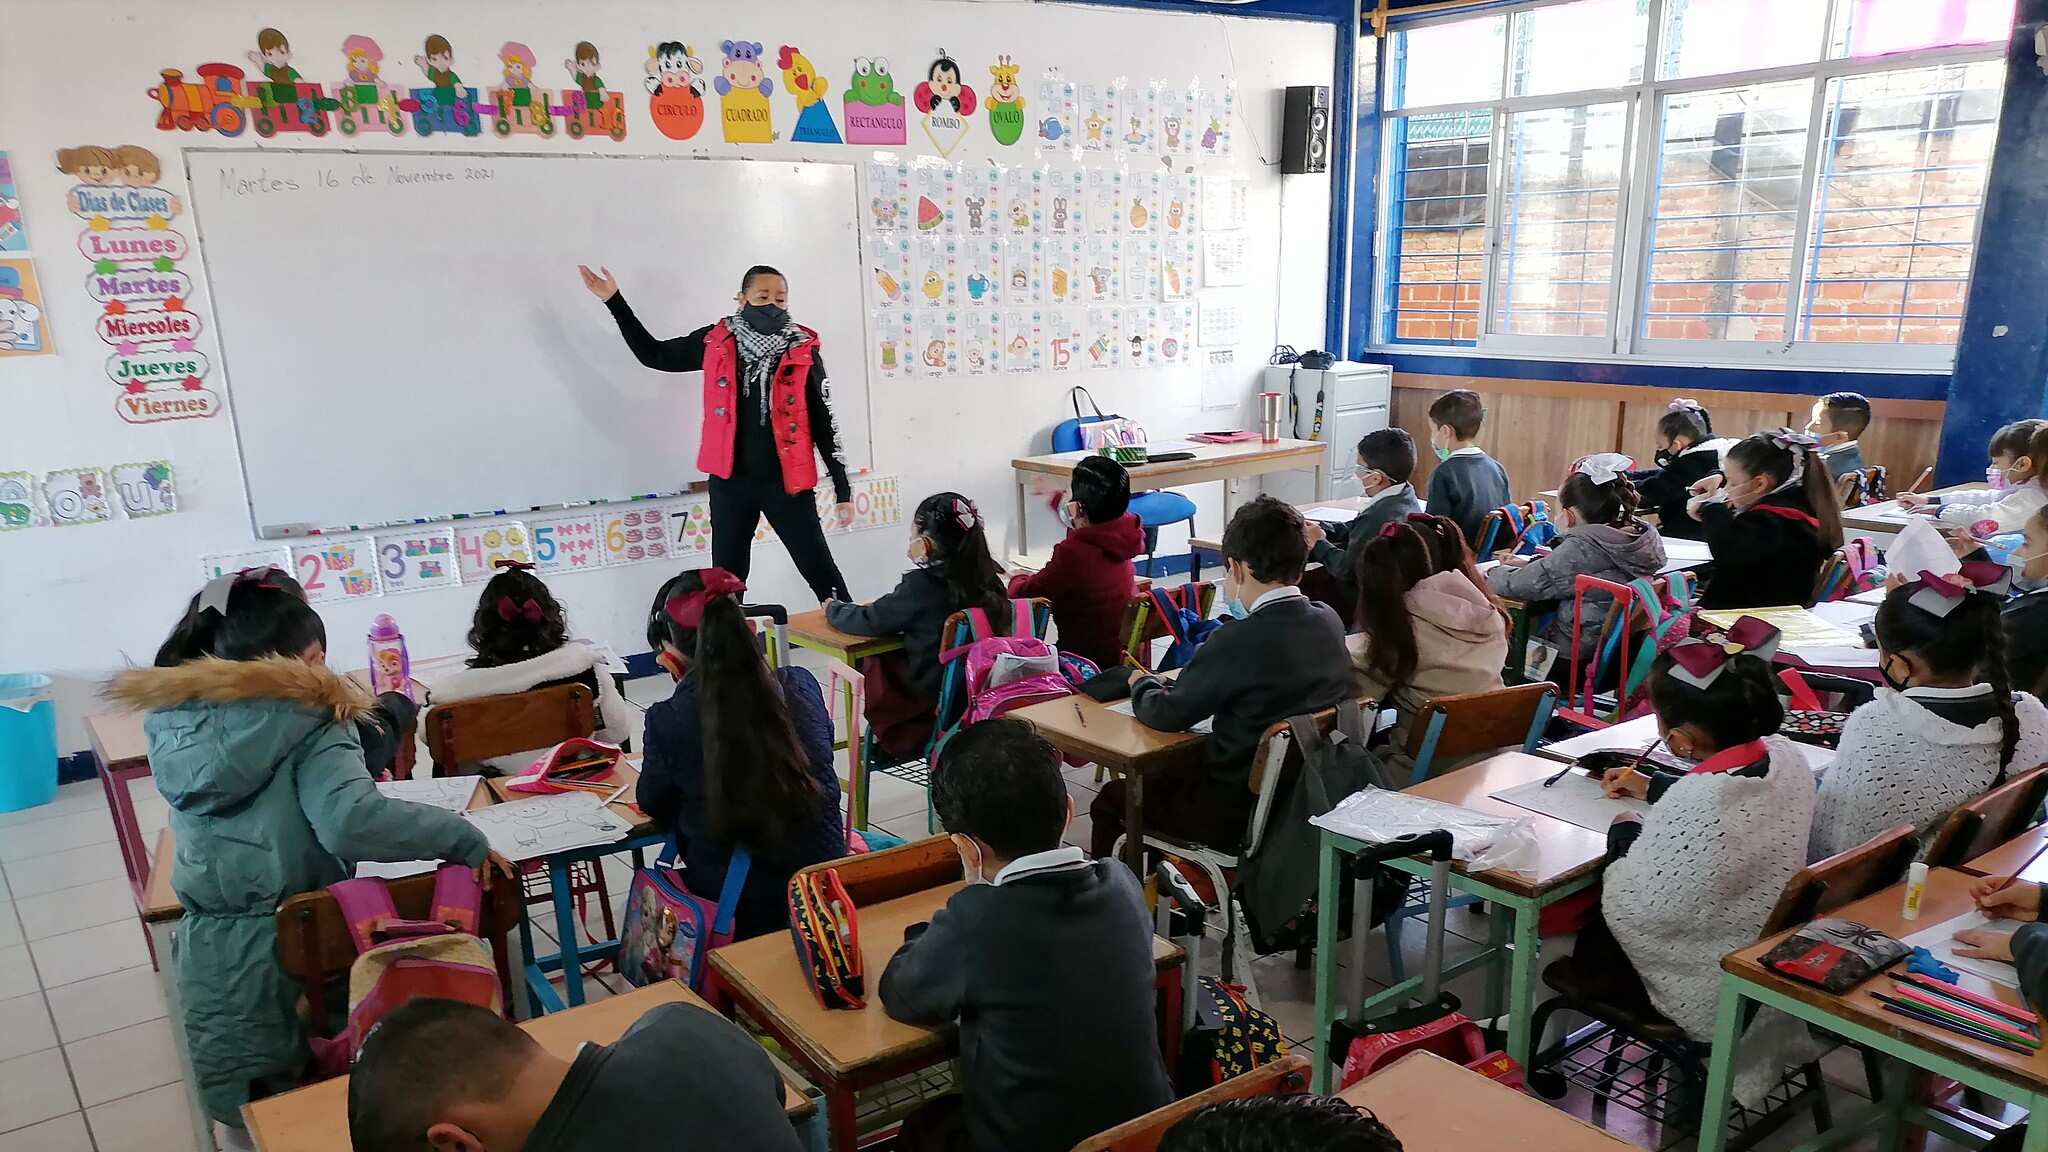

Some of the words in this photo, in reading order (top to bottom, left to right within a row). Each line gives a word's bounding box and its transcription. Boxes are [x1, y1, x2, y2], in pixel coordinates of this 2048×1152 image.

[453, 99, 470, 128] 6
[529, 101, 547, 127] 8
[656, 104, 698, 117] CIRCULO
[725, 108, 769, 122] CUADRADO
[993, 111, 1021, 124] OVALO
[849, 115, 904, 130] RECTANGULO
[931, 116, 961, 129] ROMBO
[219, 167, 300, 196] Martes
[317, 168, 339, 189] 16
[352, 162, 376, 186] de
[464, 167, 495, 182] 2021
[110, 191, 126, 212] de
[127, 191, 168, 212] Clases
[89, 235, 177, 254] Lunes
[96, 277, 181, 296] Martes
[104, 316, 190, 338] Miercoles
[1050, 338, 1070, 366] 15
[117, 360, 198, 378] Jueves
[124, 397, 208, 415] Viernes
[606, 519, 625, 553] 6
[671, 511, 689, 543] 7
[460, 535, 483, 568] 4
[534, 526, 556, 561] 5
[381, 543, 406, 579] 3
[299, 554, 326, 591] 2
